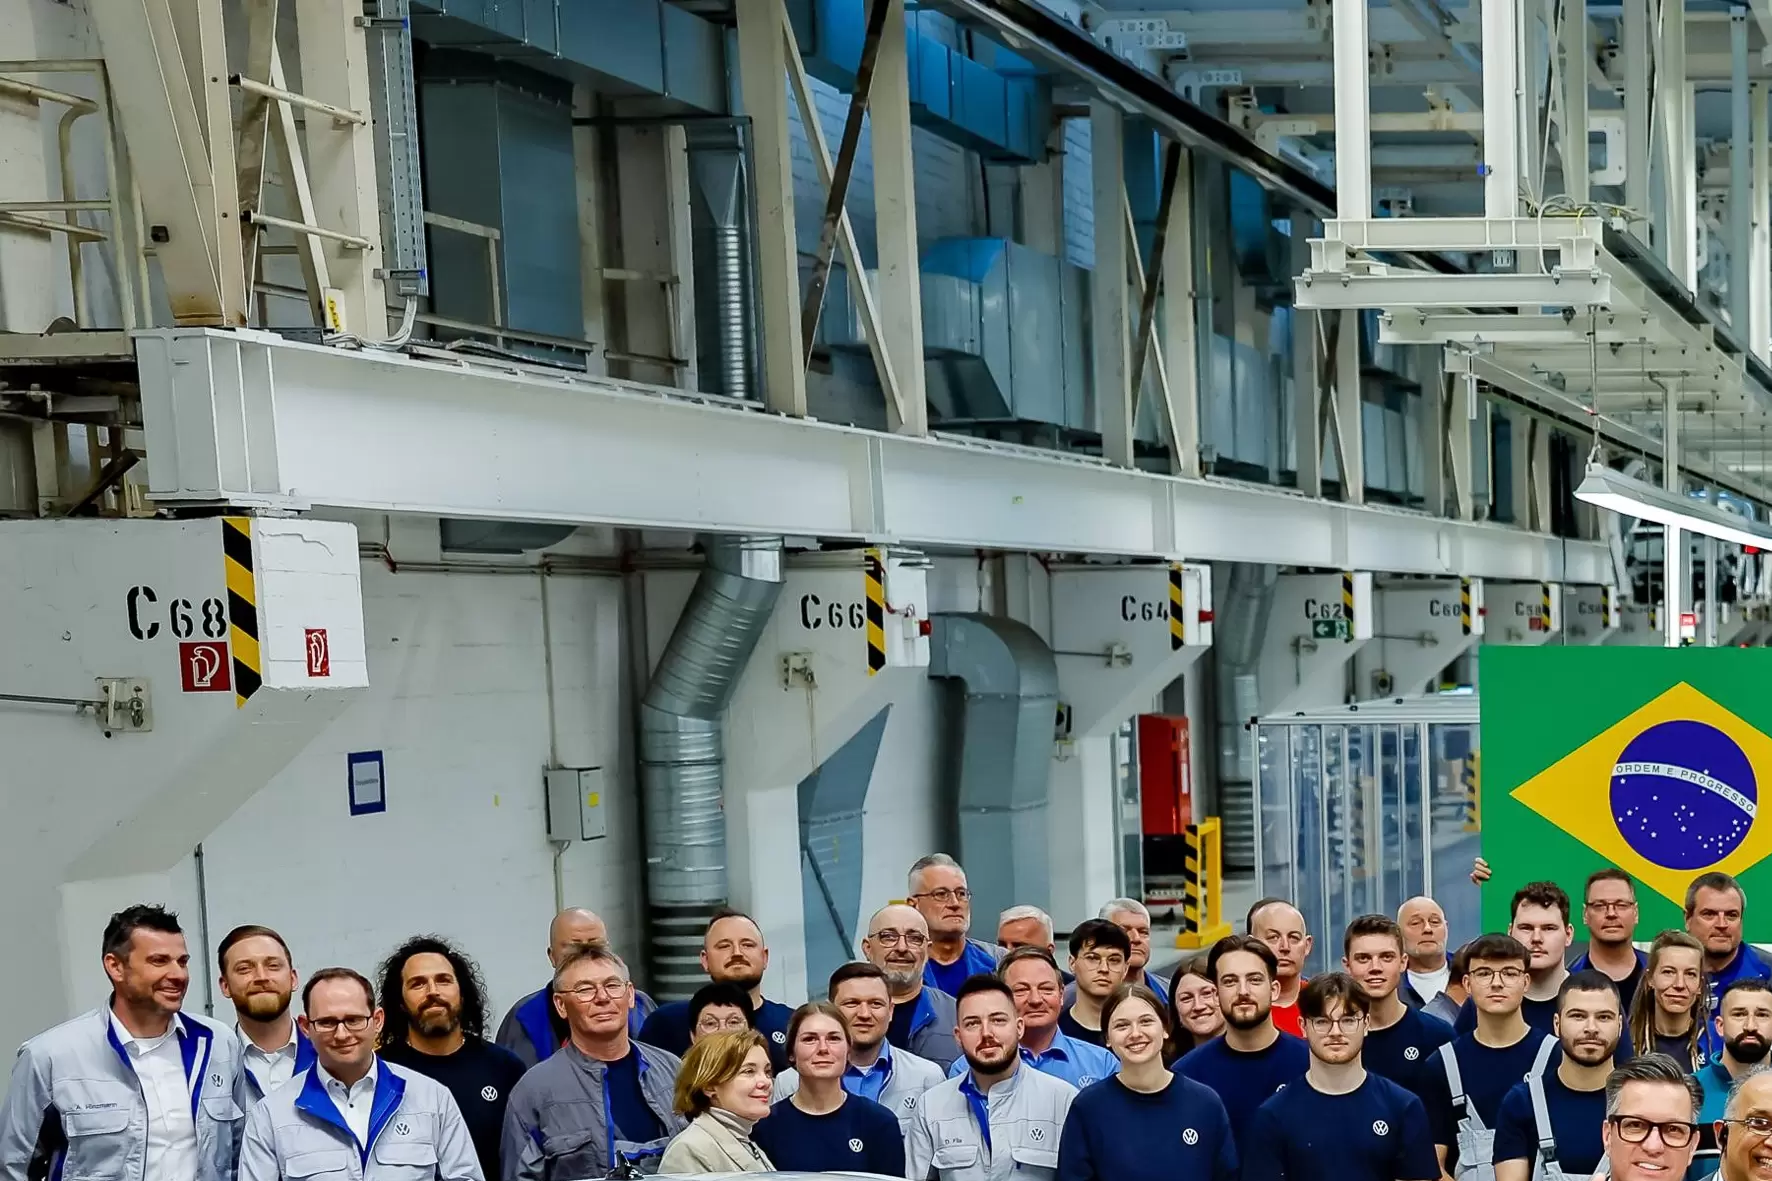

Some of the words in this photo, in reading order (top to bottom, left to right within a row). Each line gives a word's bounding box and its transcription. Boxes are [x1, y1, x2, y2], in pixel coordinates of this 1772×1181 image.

[1616, 764, 1660, 774] ORDEM
[1667, 767, 1674, 775] E
[1680, 770, 1754, 812] PROGRESSO
[771, 1031, 787, 1044] VW
[1404, 1046, 1419, 1060] VW
[210, 1073, 224, 1088] VW
[481, 1085, 498, 1102] VW
[903, 1096, 917, 1110] VW
[394, 1122, 411, 1136] VW
[1029, 1127, 1046, 1142] VW
[1372, 1120, 1389, 1136] VW
[1182, 1128, 1199, 1145] VW
[848, 1138, 864, 1153] VW
